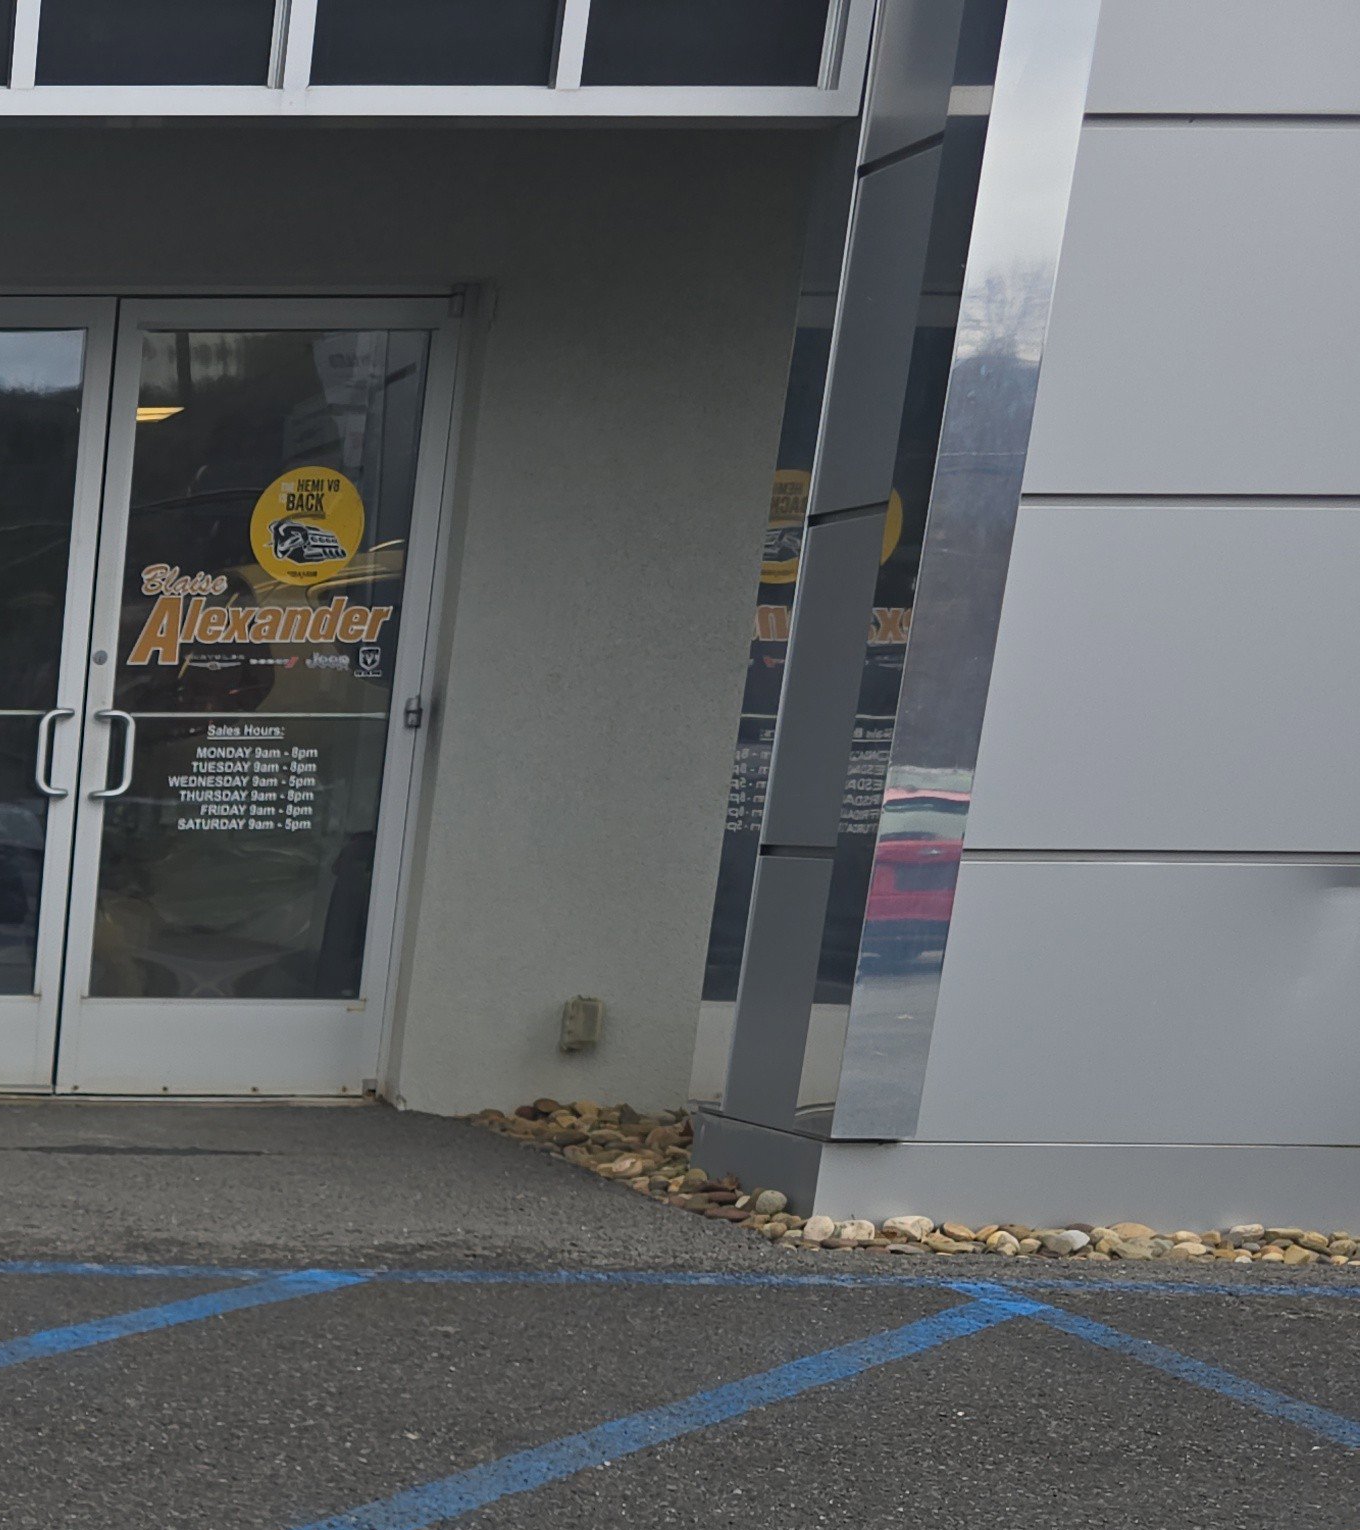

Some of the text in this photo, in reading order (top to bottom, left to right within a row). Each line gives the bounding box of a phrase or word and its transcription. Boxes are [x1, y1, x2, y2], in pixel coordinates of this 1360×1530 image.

[297, 479, 324, 492] HEMI
[327, 479, 340, 492] V8
[286, 493, 325, 512] BACK
[141, 563, 228, 596] Blaise
[126, 595, 393, 666] Alexander
[207, 724, 285, 736] Sales Hours:
[196, 746, 253, 759] MONDAY
[254, 747, 281, 758] 9am
[191, 761, 251, 773] TUESDAY
[253, 761, 279, 773] 9am
[168, 775, 250, 787] WEDNESDAY
[252, 776, 278, 787] 9am
[180, 790, 248, 802] THURSDAY
[251, 790, 277, 802] 9am
[200, 804, 247, 816] FRIDAY
[249, 804, 275, 816] 9am
[178, 818, 246, 830] SATURDAY
[248, 818, 274, 830] 9am
